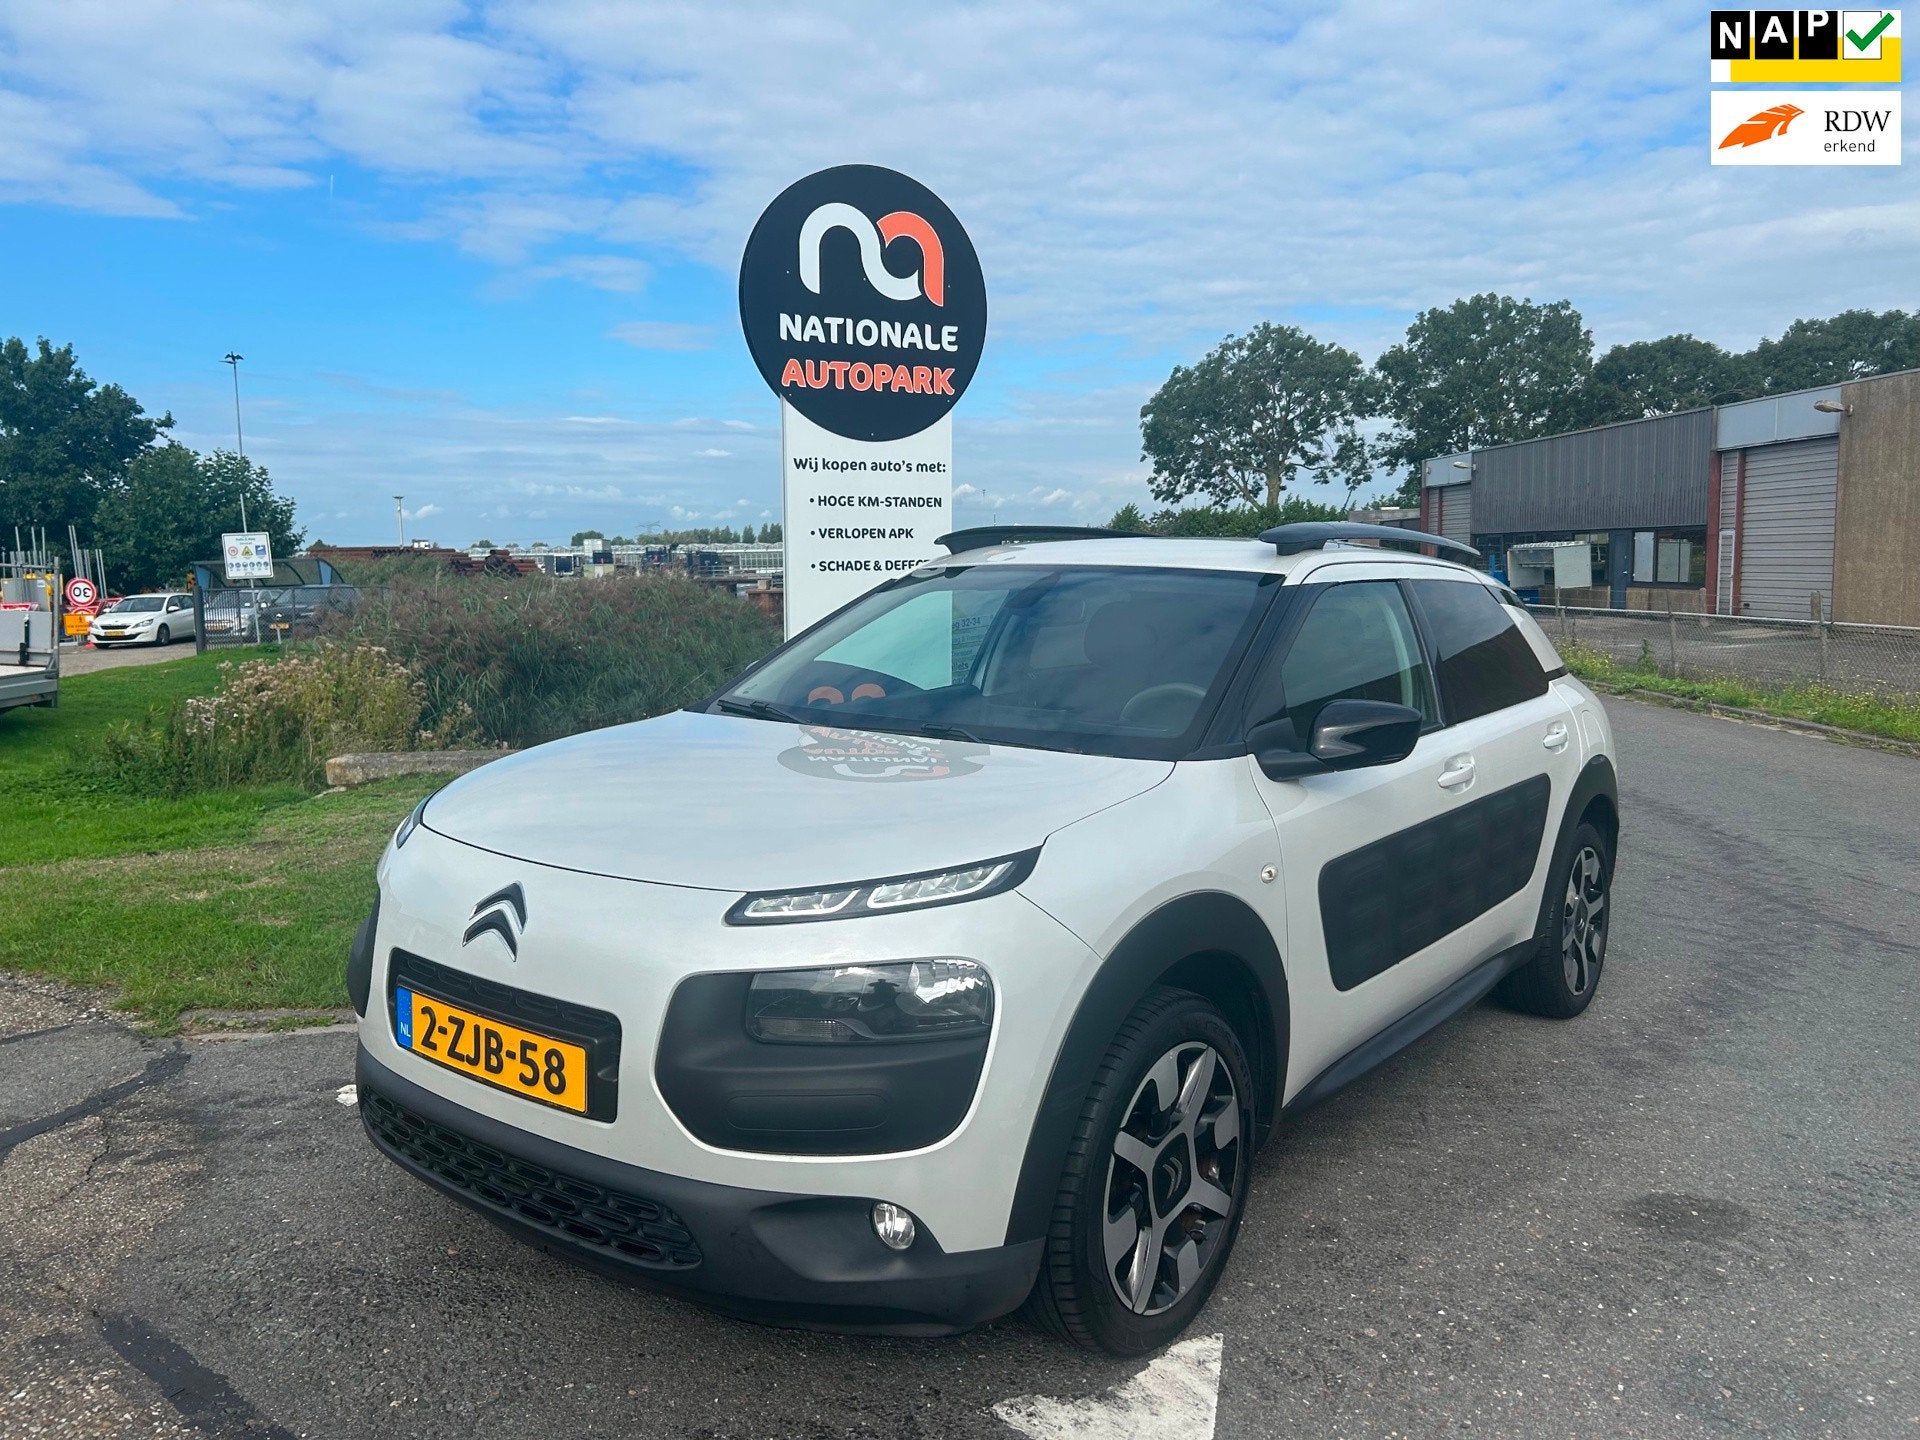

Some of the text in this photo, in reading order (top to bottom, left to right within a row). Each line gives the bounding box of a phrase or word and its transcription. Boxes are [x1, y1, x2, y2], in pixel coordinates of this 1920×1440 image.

[779, 312, 959, 352] NATIONALE
[781, 358, 956, 396] AUTOPARK
[793, 457, 946, 474] Wij kopen auto's met:
[818, 495, 942, 508] HOGE KM-STANDEN
[819, 528, 914, 539] VERLOPEN APK
[819, 559, 930, 572] SCHADE & DEFEC
[400, 1021, 411, 1038] NL
[420, 1006, 566, 1094] 2-ZJB-58
